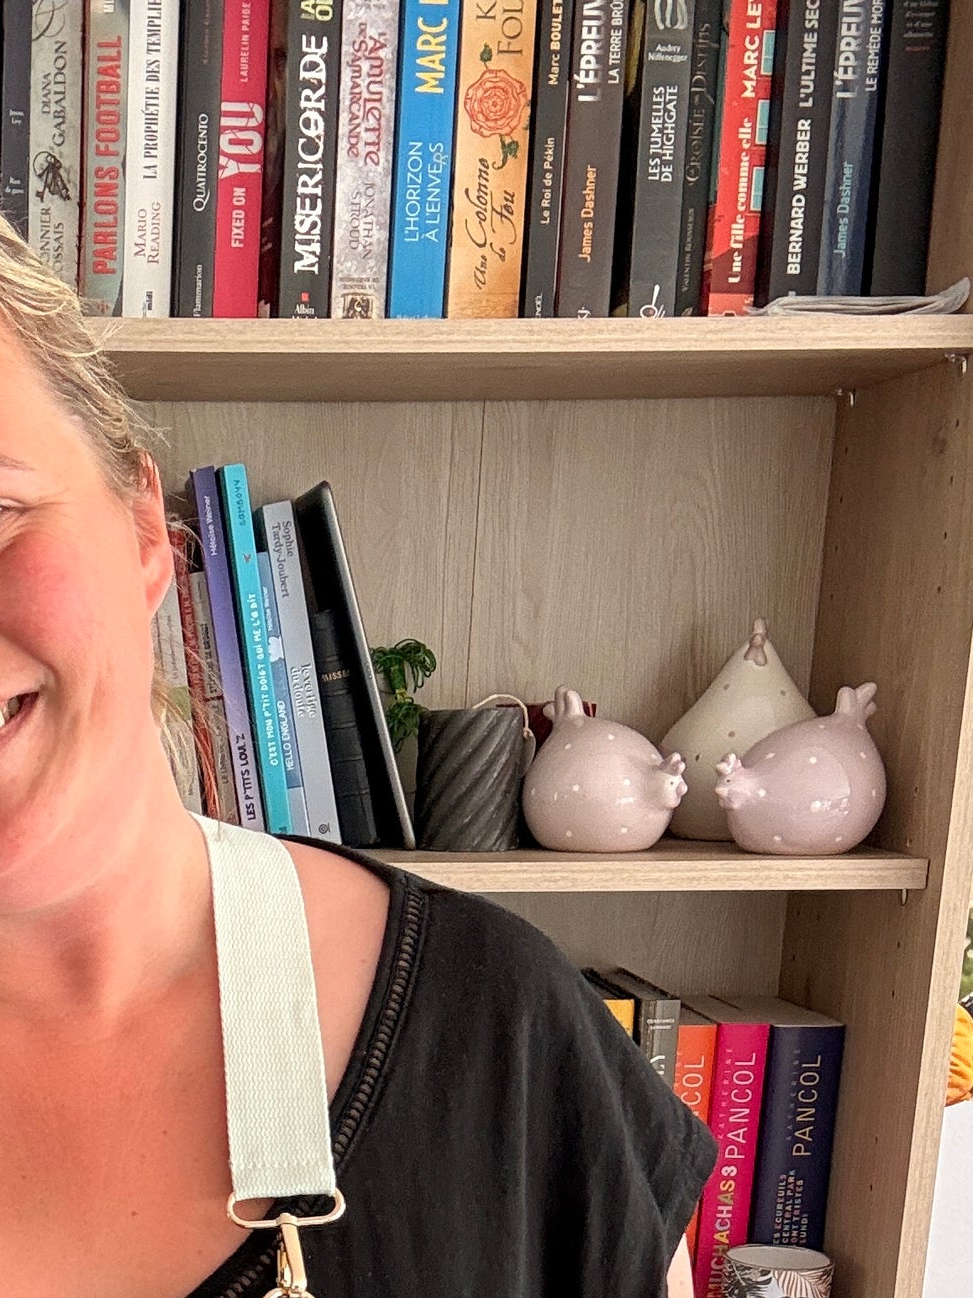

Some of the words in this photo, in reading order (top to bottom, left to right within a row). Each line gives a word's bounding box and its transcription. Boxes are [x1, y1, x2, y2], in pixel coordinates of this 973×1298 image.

[146, 59, 160, 82] DES
[415, 17, 447, 93] MARC
[547, 55, 560, 85] Marc
[609, 28, 623, 65] TERRE
[741, 36, 760, 97] MARC
[799, 32, 818, 107] L'ULTIME
[53, 40, 67, 146] GABALDON
[96, 36, 122, 157] FOOTBALL
[608, 69, 620, 84] LA
[865, 78, 877, 91] LE
[218, 102, 264, 179] YOU
[650, 87, 665, 154] JUMELLES
[663, 86, 678, 160] HIGHGATE
[738, 117, 753, 149] elle
[193, 113, 210, 211] QUATTROCENTO
[293, 34, 328, 274] MISERICORDE
[543, 137, 555, 169] Pékin
[648, 159, 661, 181] LES
[661, 165, 673, 182] DE
[793, 119, 811, 190] WERBER
[232, 188, 246, 205] ON
[404, 142, 423, 242] L'HORIZON
[464, 157, 490, 248] Colonne
[540, 189, 552, 207] Roi
[542, 173, 552, 186] de
[581, 165, 597, 217] Dashner
[738, 152, 751, 211] comme
[837, 160, 854, 213] Dashner
[92, 166, 119, 275] PARLONS
[134, 209, 147, 256] MARIO
[148, 202, 161, 264] READING
[231, 210, 245, 248] FIXED
[490, 190, 517, 244] Feu
[540, 211, 551, 223] Le
[579, 222, 594, 262] James
[730, 214, 746, 248] fille
[787, 195, 805, 274] BERNARD
[834, 218, 850, 258] James
[193, 264, 203, 317] Flammarion
[728, 251, 743, 283] Une
[282, 520, 296, 557] Sophie
[277, 700, 291, 741] ENGLAND
[284, 744, 295, 770] HELLO
[245, 803, 256, 820] LES
[725, 1052, 757, 1159] PANCOL
[791, 1055, 823, 1156] PANCOL
[707, 1180, 736, 1298] MUCHACHAS
[722, 1166, 737, 1177] 3
